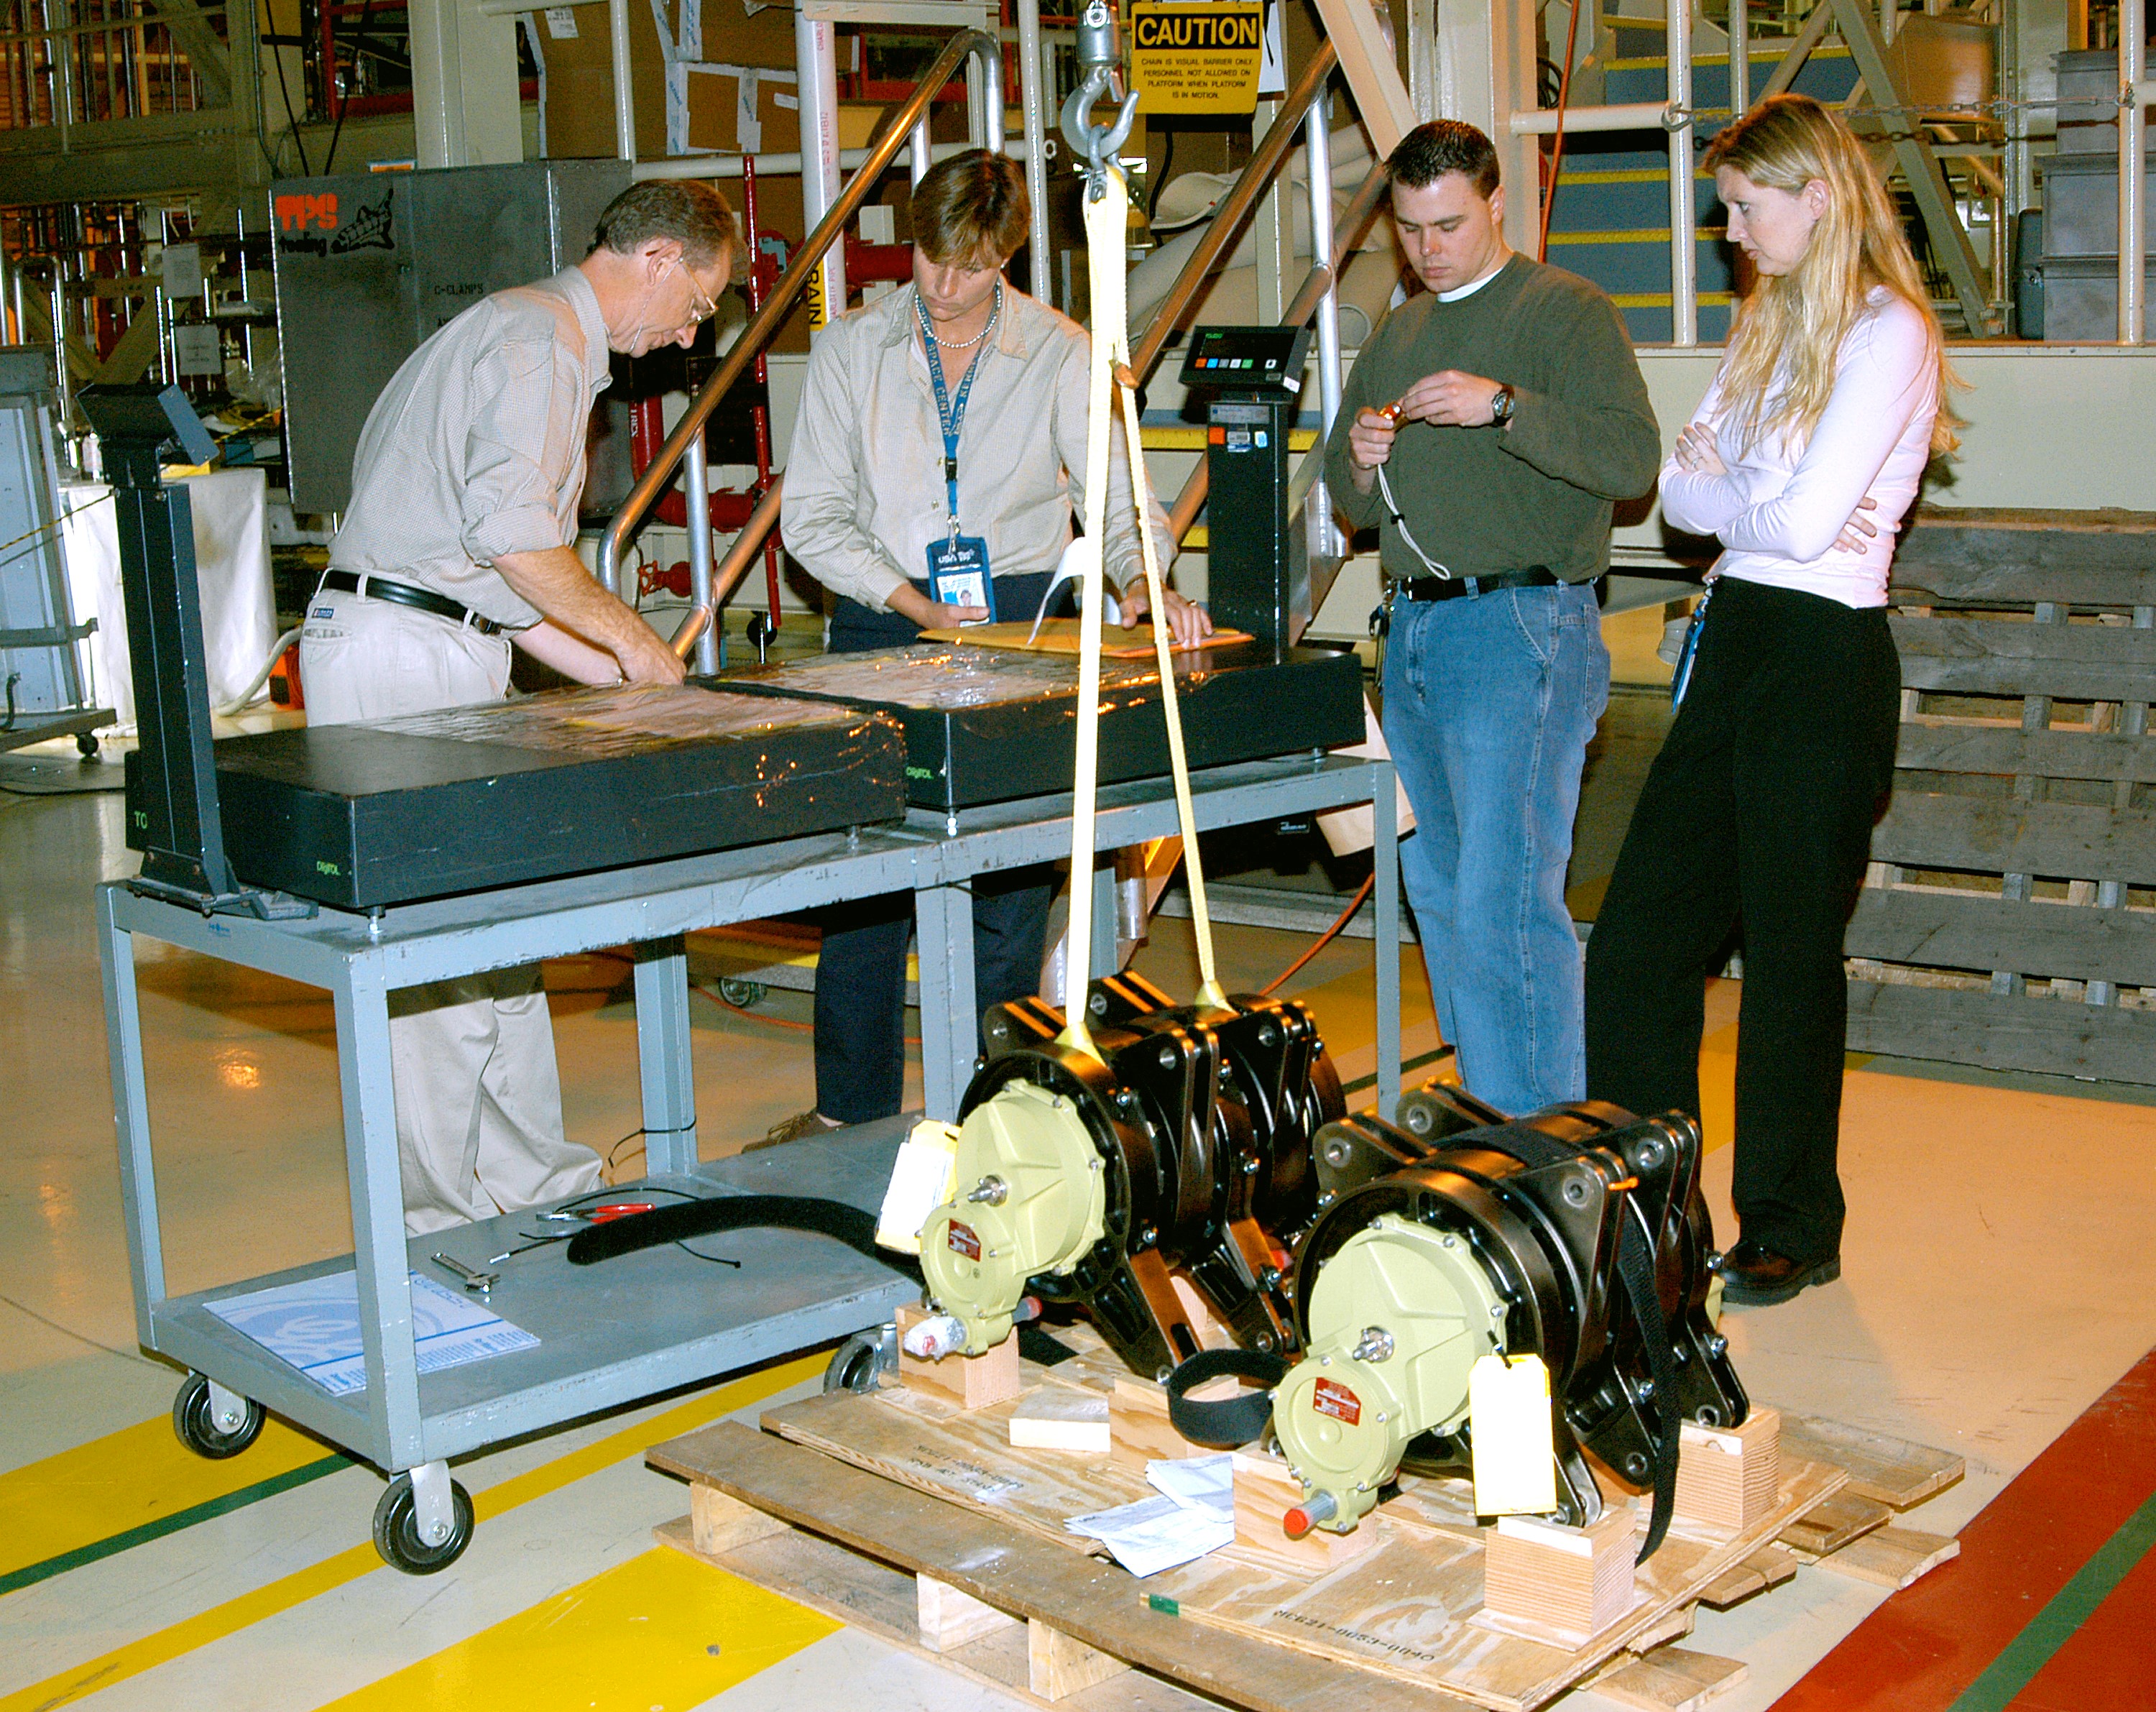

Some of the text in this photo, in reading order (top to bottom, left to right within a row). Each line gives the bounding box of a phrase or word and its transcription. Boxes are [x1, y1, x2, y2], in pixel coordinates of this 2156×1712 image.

[1138, 17, 1257, 46] CAUTION
[275, 193, 338, 231] TPS
[926, 343, 943, 383] SPACE
[936, 387, 953, 436] CENTER
